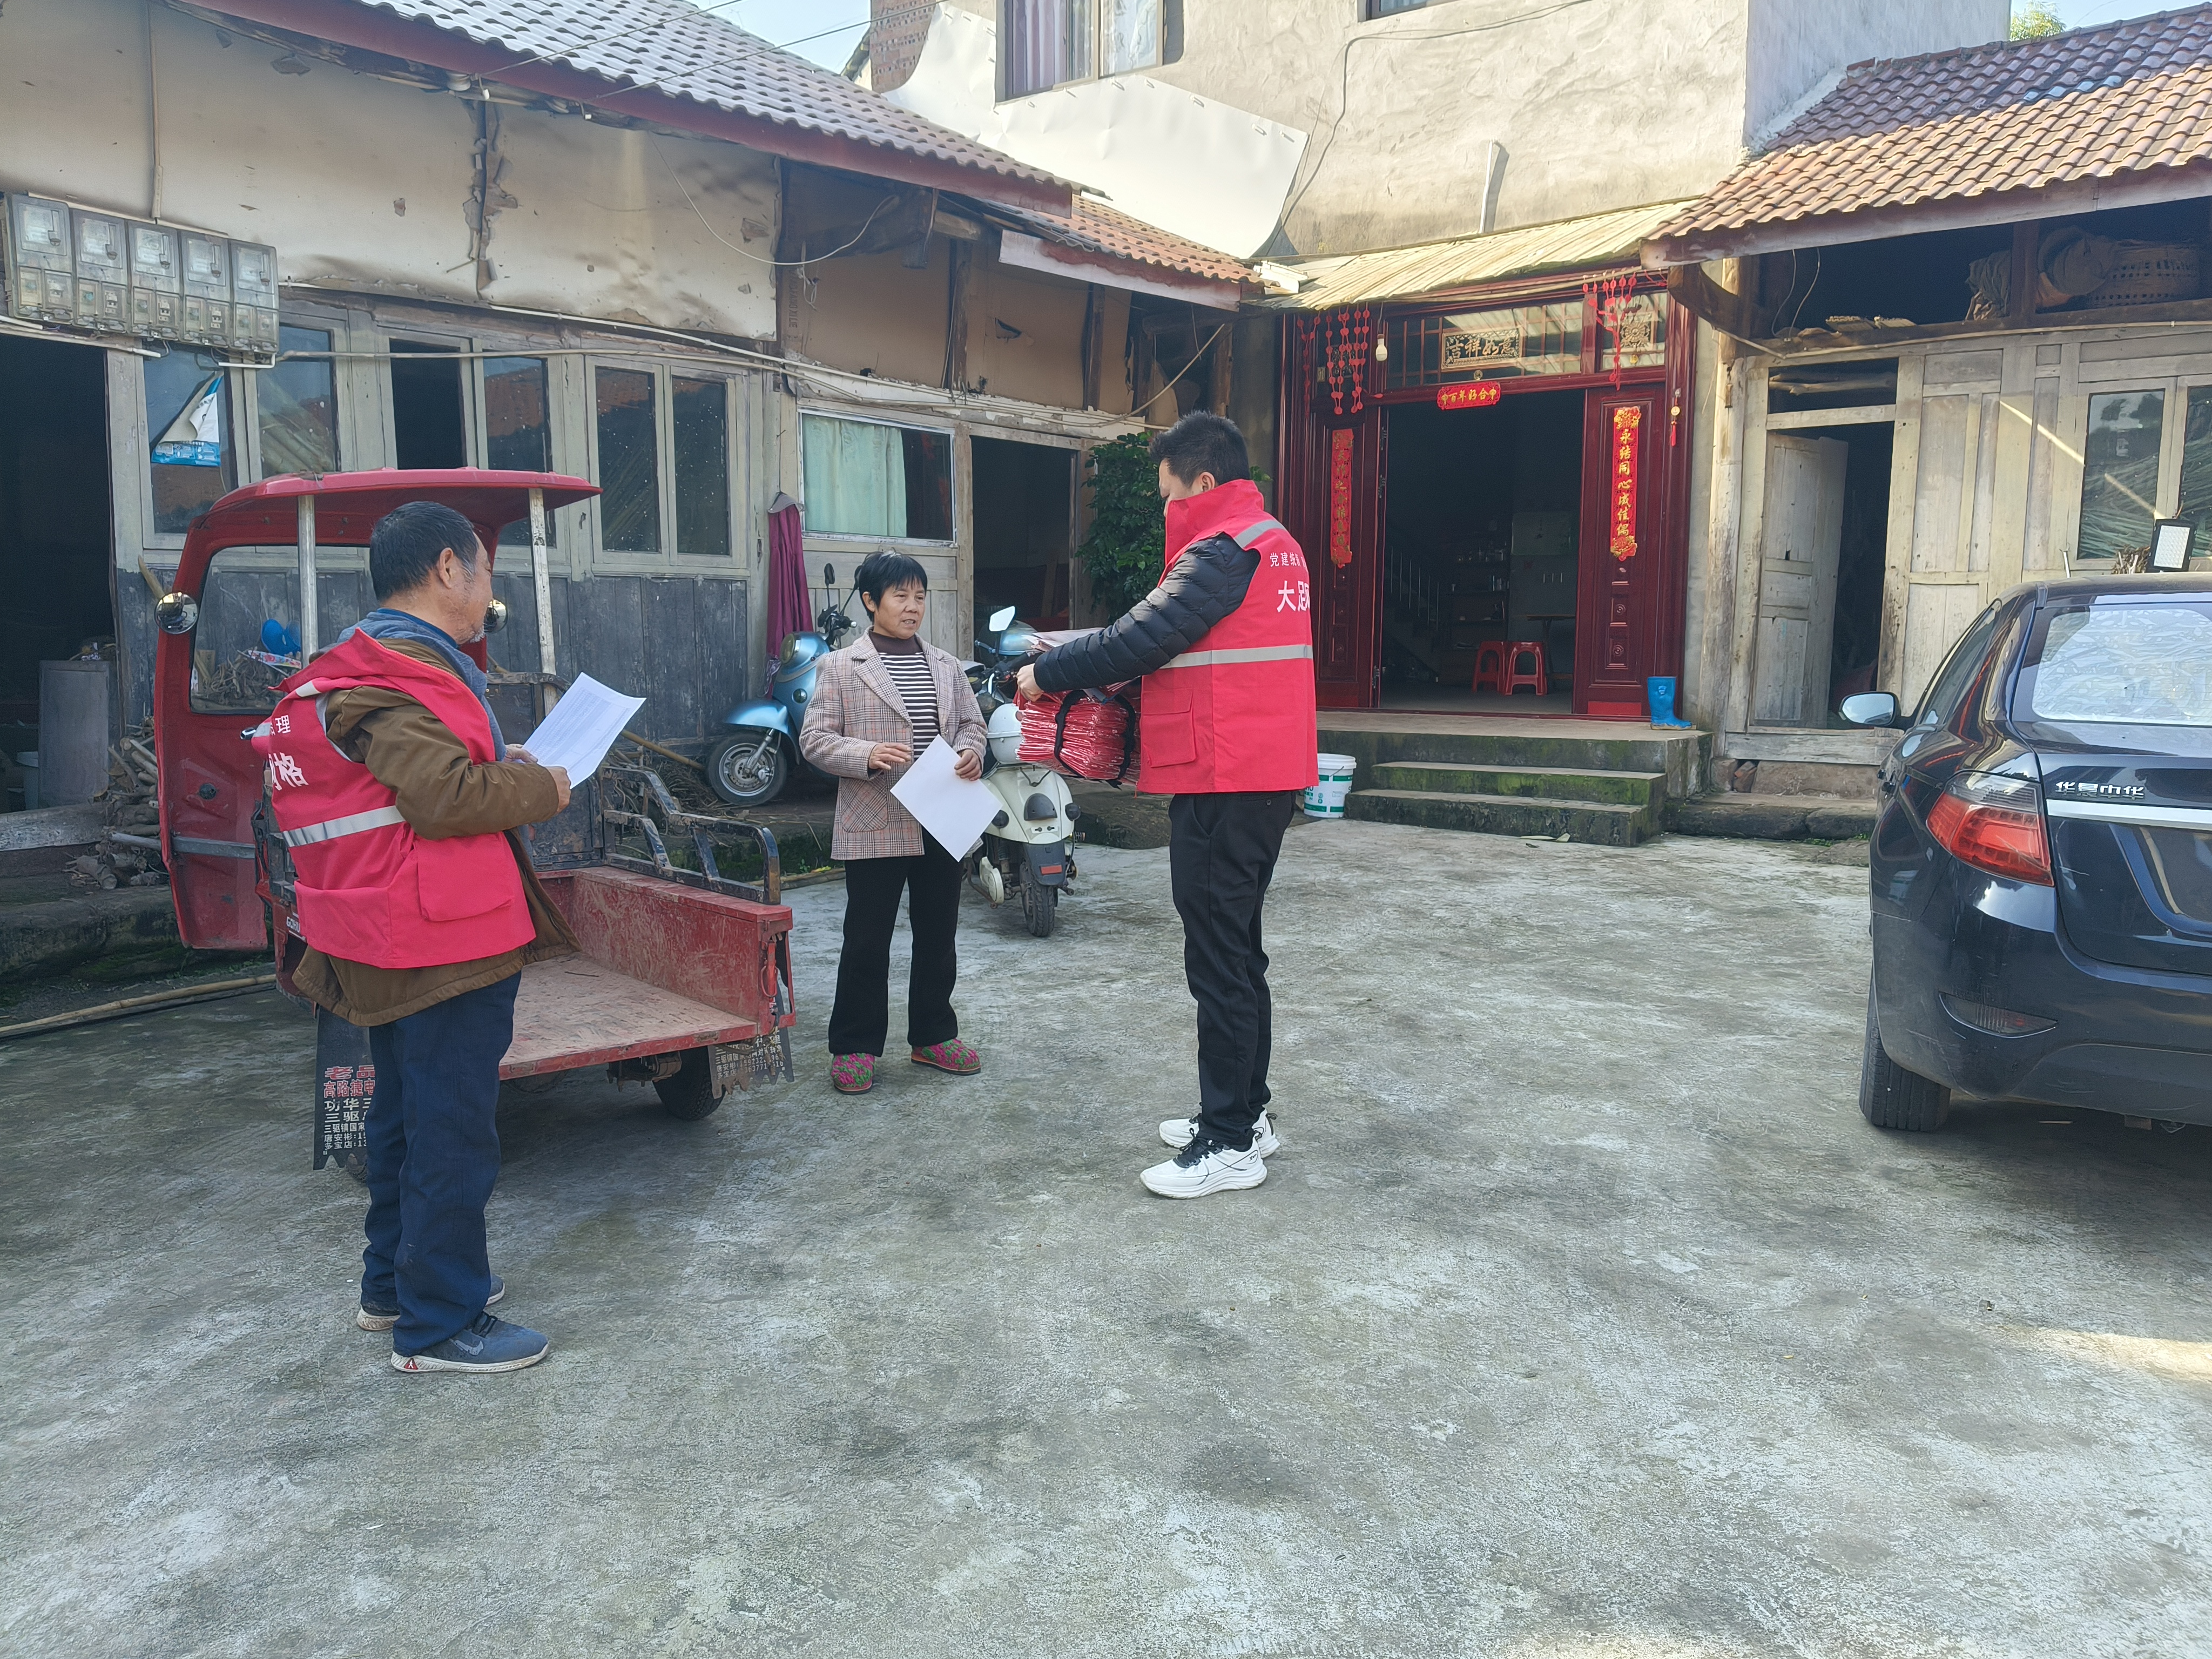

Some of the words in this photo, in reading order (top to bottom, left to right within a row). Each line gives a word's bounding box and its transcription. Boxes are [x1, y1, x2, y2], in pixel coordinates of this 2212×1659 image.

[1446, 336, 1516, 360] 吉祥如意
[1448, 387, 1489, 403] 百年好合
[1616, 429, 1634, 536] 永结同心成佳偶
[2055, 781, 2144, 800] 华晨中华
[325, 1110, 368, 1123] 三驱
